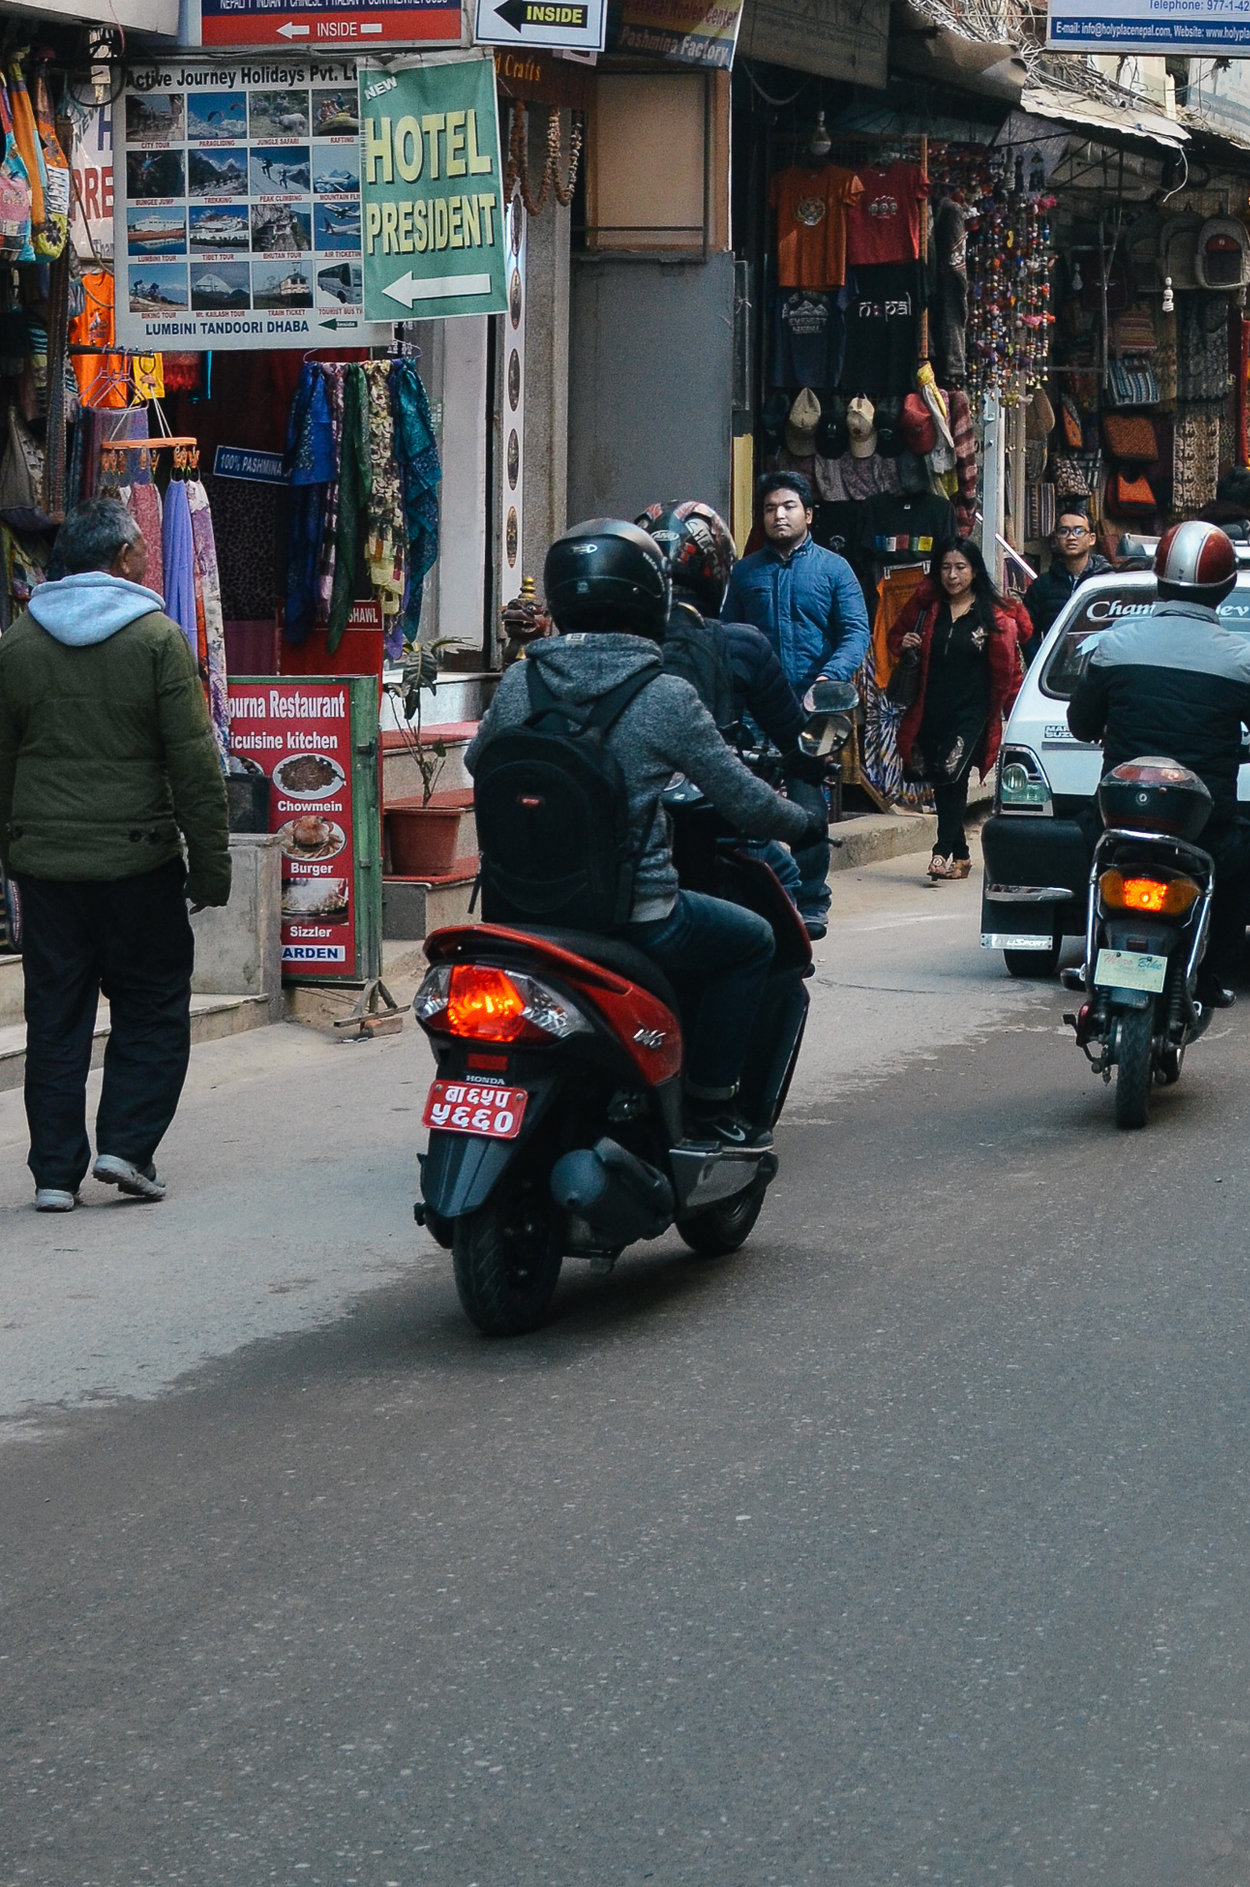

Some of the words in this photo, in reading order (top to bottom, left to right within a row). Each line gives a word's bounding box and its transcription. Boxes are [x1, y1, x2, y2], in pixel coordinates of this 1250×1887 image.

[526, 5, 584, 24] INSIDE
[316, 21, 358, 37] INSIDE
[1055, 22, 1080, 35] E-mail:
[1173, 25, 1205, 39] Website:
[680, 35, 730, 66] Factory
[176, 66, 237, 90] Journey
[240, 65, 306, 88] Holidays
[310, 64, 339, 83] Pvt.
[363, 75, 398, 101] NEW
[364, 108, 493, 184] HOTEL
[366, 193, 497, 255] PRESIDENT
[145, 322, 197, 336] LUMBINI
[199, 321, 264, 335] TANDOORI
[267, 320, 310, 334] DHABA
[268, 689, 346, 719] Restaurant
[286, 731, 339, 750] kitchen
[276, 800, 343, 813] Chowmein
[289, 862, 334, 876] Burger
[289, 925, 332, 938] Sizzler
[465, 1074, 506, 1085] HONDA
